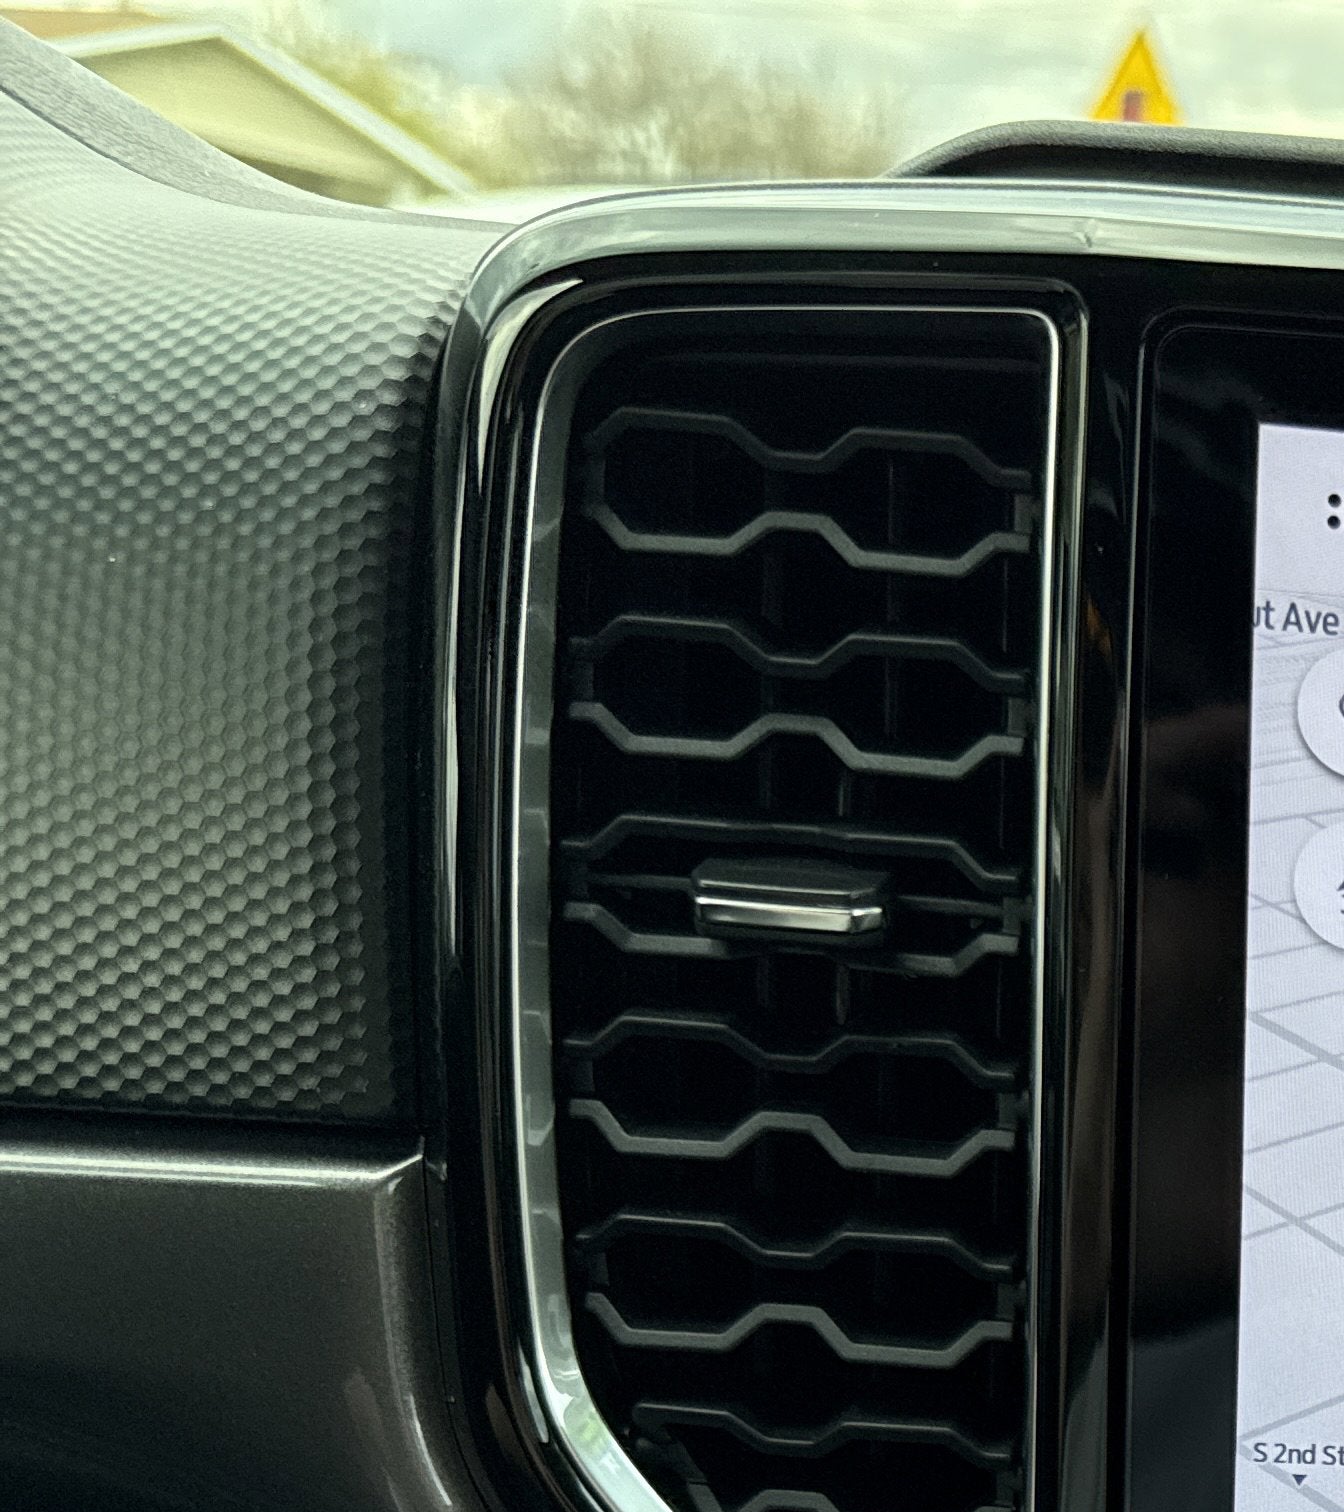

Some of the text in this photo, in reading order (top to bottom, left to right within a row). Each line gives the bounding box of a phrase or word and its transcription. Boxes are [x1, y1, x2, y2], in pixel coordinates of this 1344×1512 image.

[1282, 601, 1340, 636] Ave
[1253, 1442, 1268, 1463] S
[1273, 1442, 1317, 1465] 2nd
